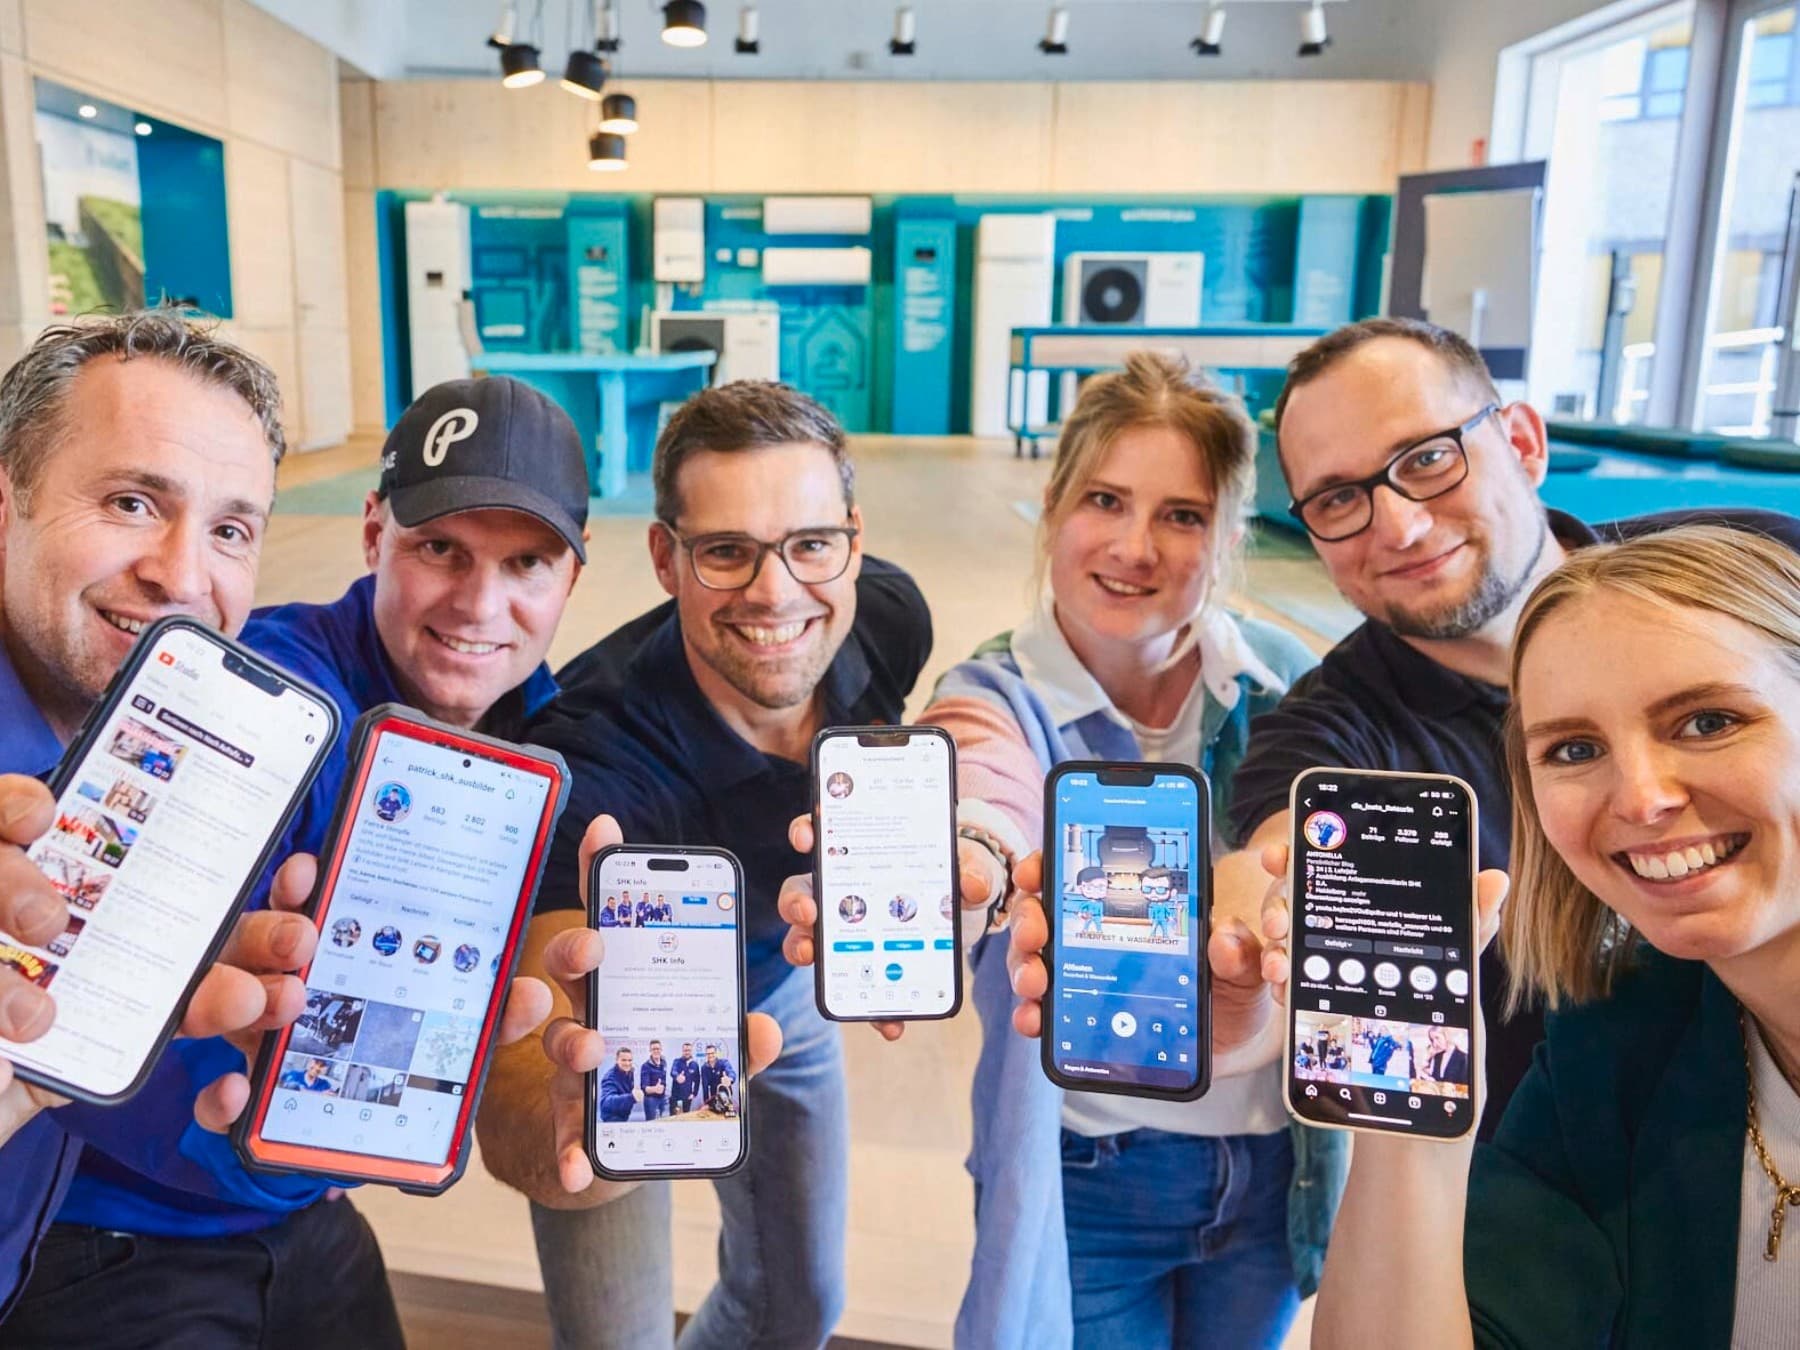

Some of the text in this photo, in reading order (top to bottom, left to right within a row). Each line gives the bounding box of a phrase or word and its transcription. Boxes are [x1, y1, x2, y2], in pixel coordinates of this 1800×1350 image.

[423, 408, 479, 467] P
[407, 762, 496, 793] patrick_shk_ausbilder
[431, 805, 446, 816] 683
[669, 957, 685, 965] Info
